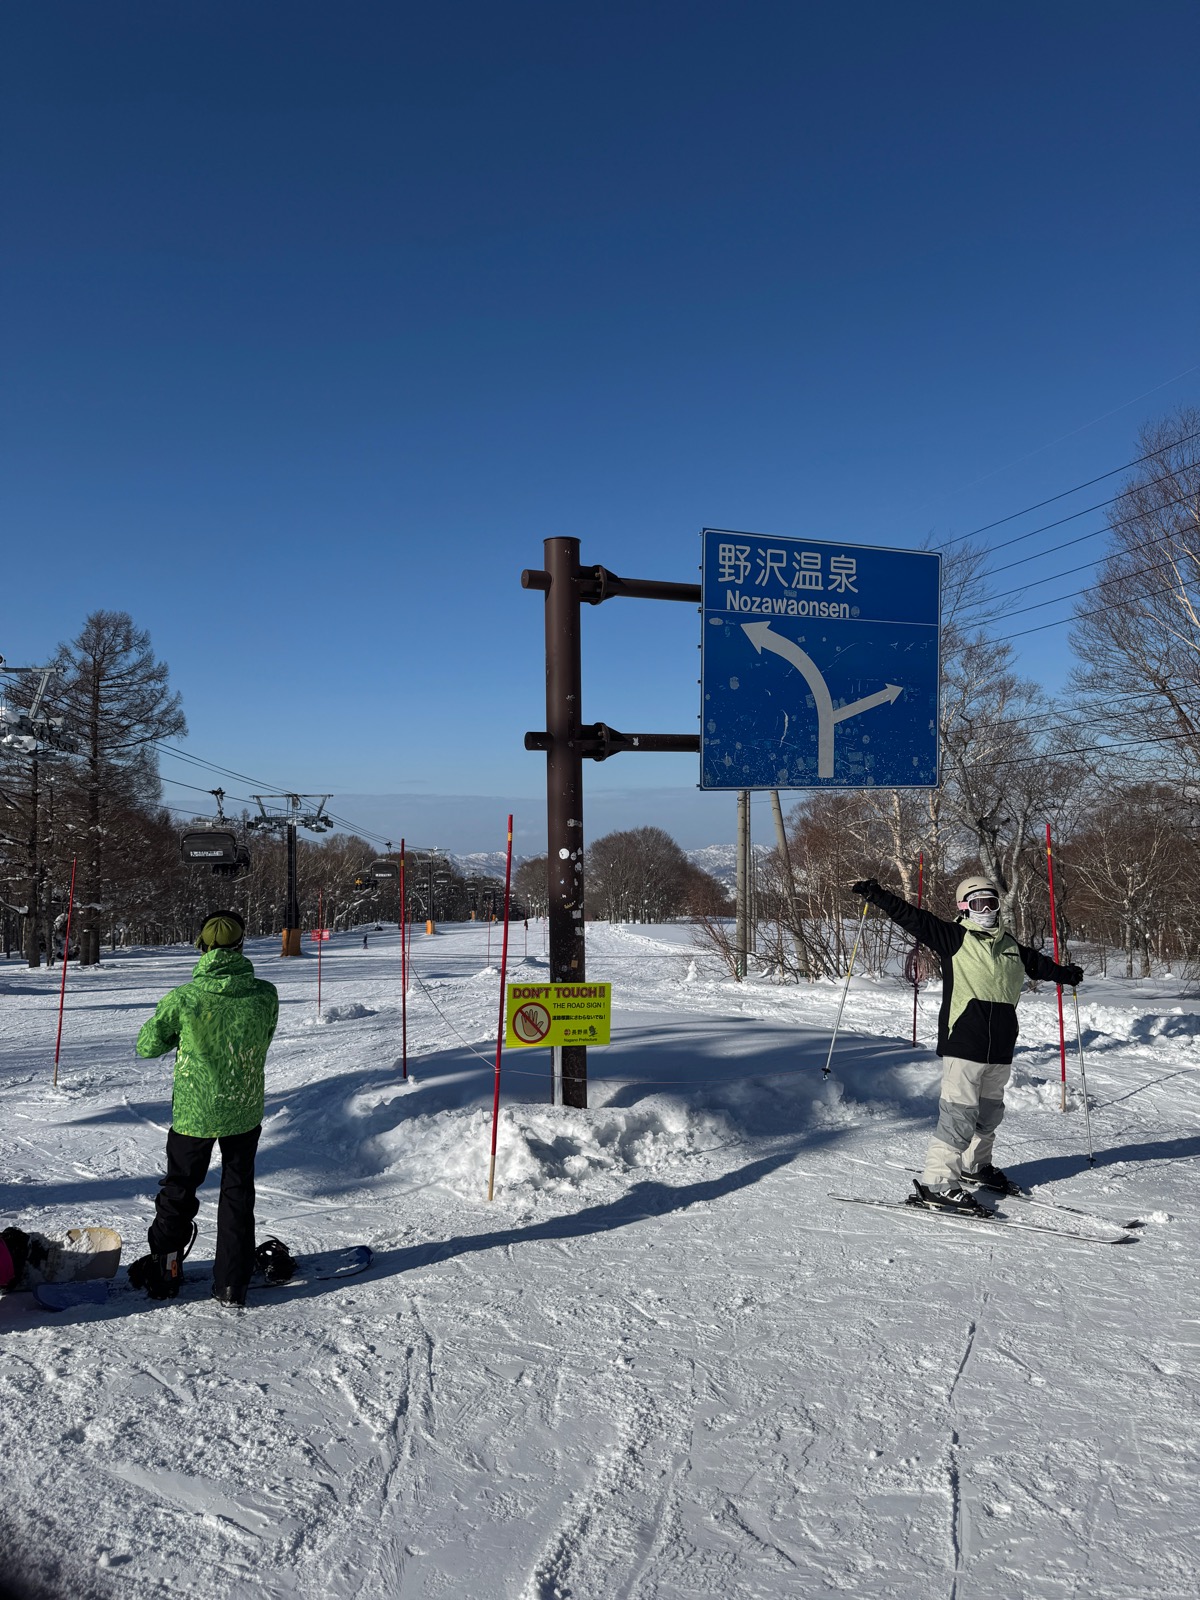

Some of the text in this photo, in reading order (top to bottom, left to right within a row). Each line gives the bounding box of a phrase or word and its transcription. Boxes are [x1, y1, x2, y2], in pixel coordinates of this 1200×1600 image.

[718, 543, 858, 593] 野沢温泉
[726, 590, 850, 619] Nozawaonsen
[513, 988, 551, 999] DON'T
